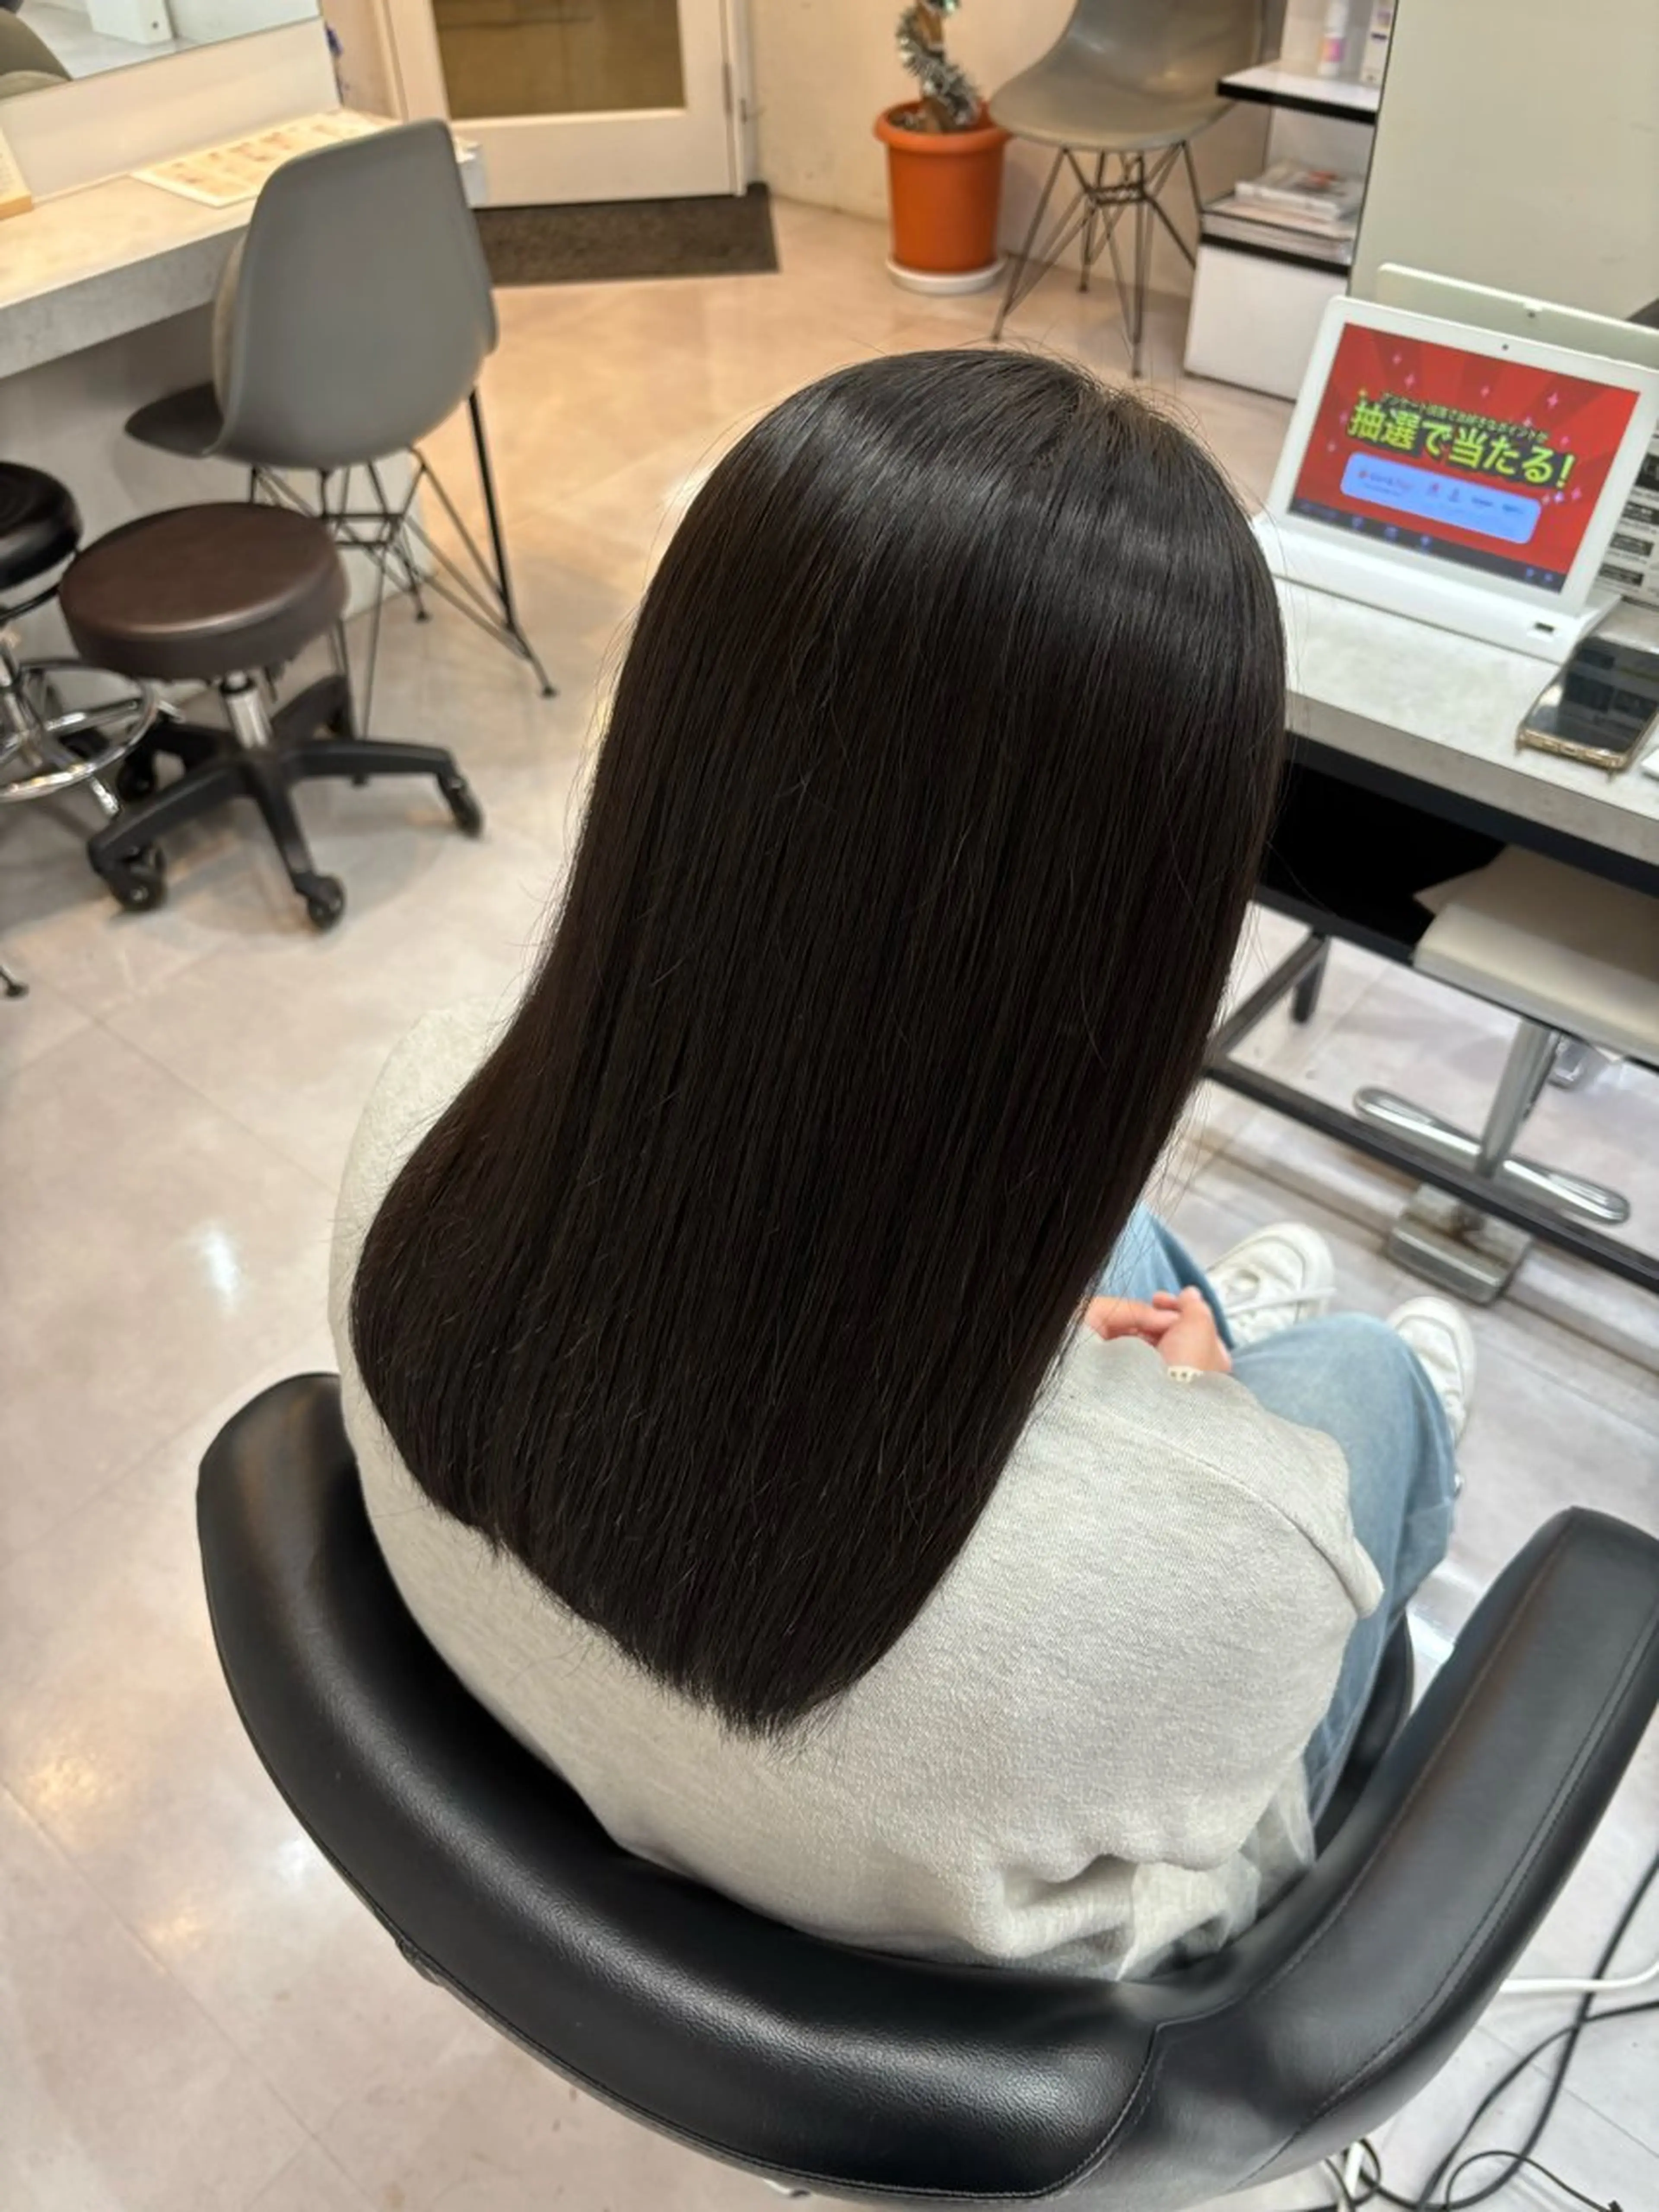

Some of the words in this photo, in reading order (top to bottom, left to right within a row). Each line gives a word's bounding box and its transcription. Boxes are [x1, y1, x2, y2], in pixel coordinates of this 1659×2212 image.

[1348, 401, 1575, 488] 抽選で当たる!
